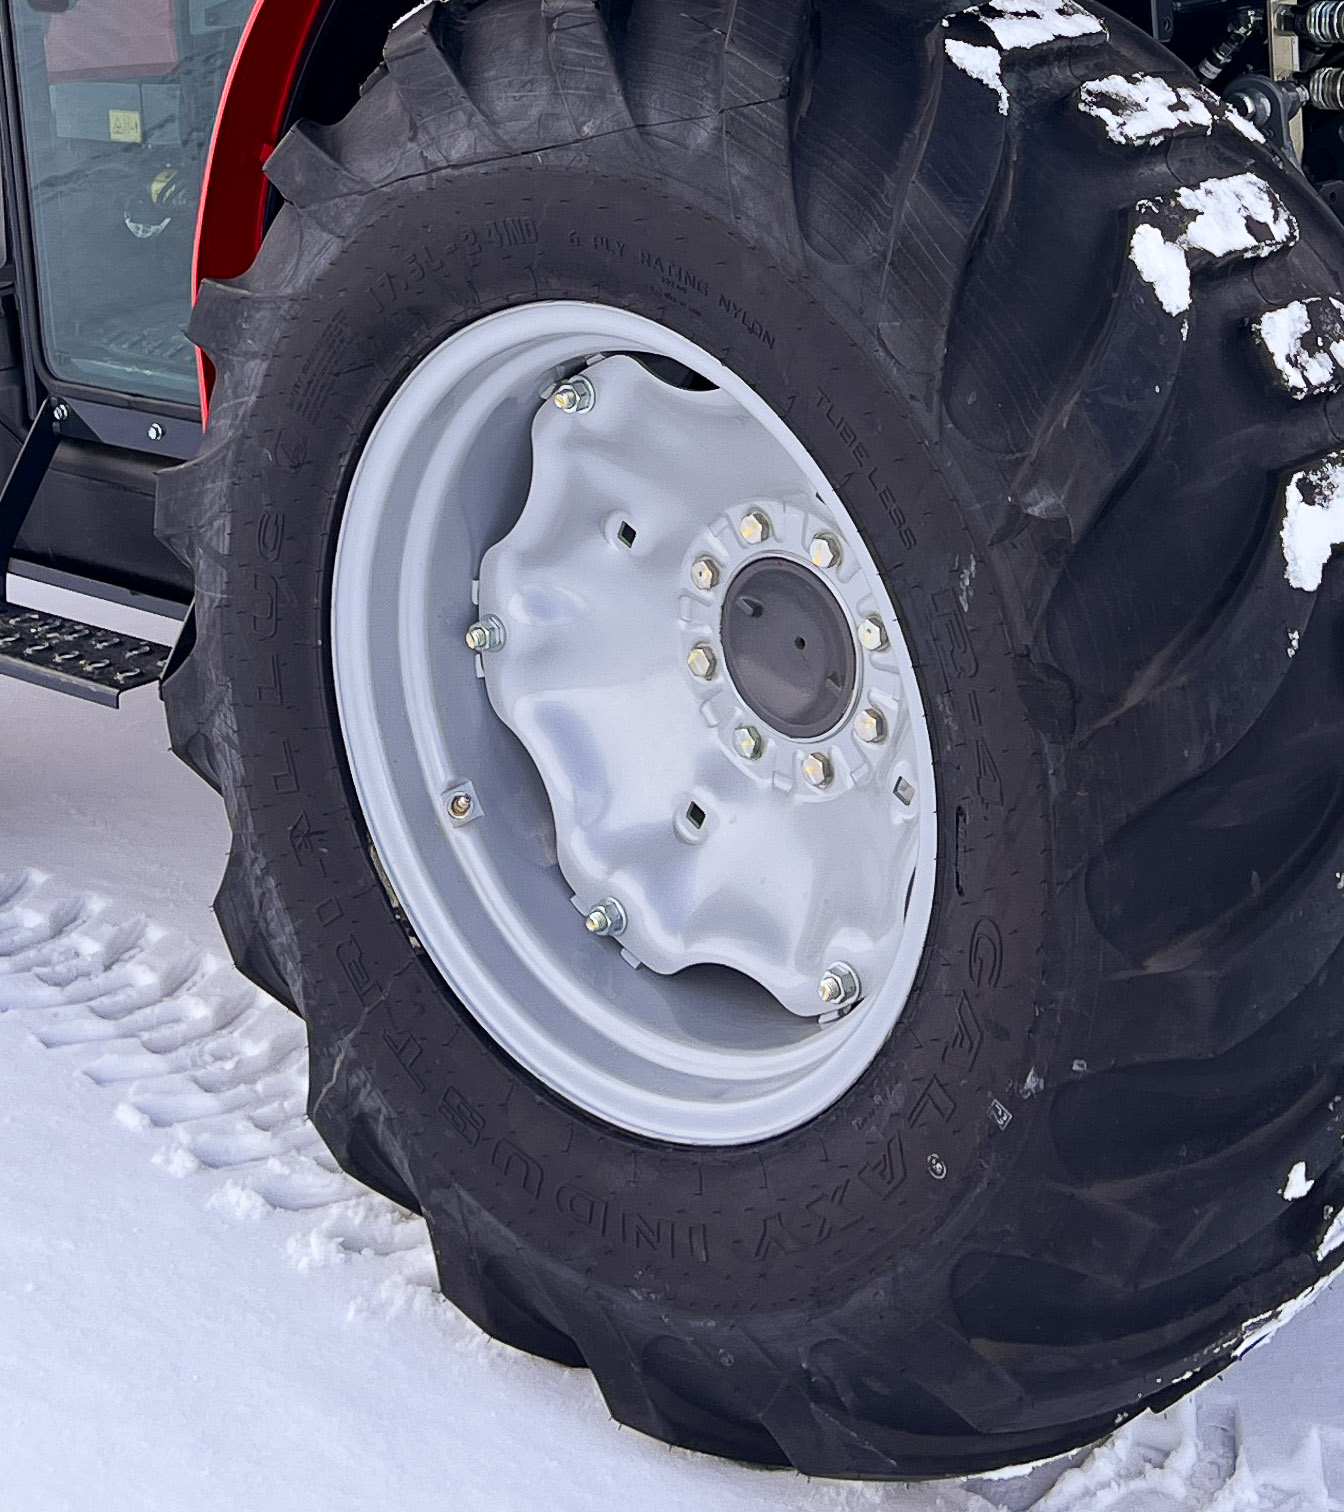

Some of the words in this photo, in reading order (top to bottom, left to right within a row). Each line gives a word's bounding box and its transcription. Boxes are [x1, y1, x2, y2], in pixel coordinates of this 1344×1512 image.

[593, 236, 627, 258] PLY
[639, 248, 709, 297] RATING
[717, 292, 777, 351] NYLON
[813, 384, 918, 552] TUBELESS
